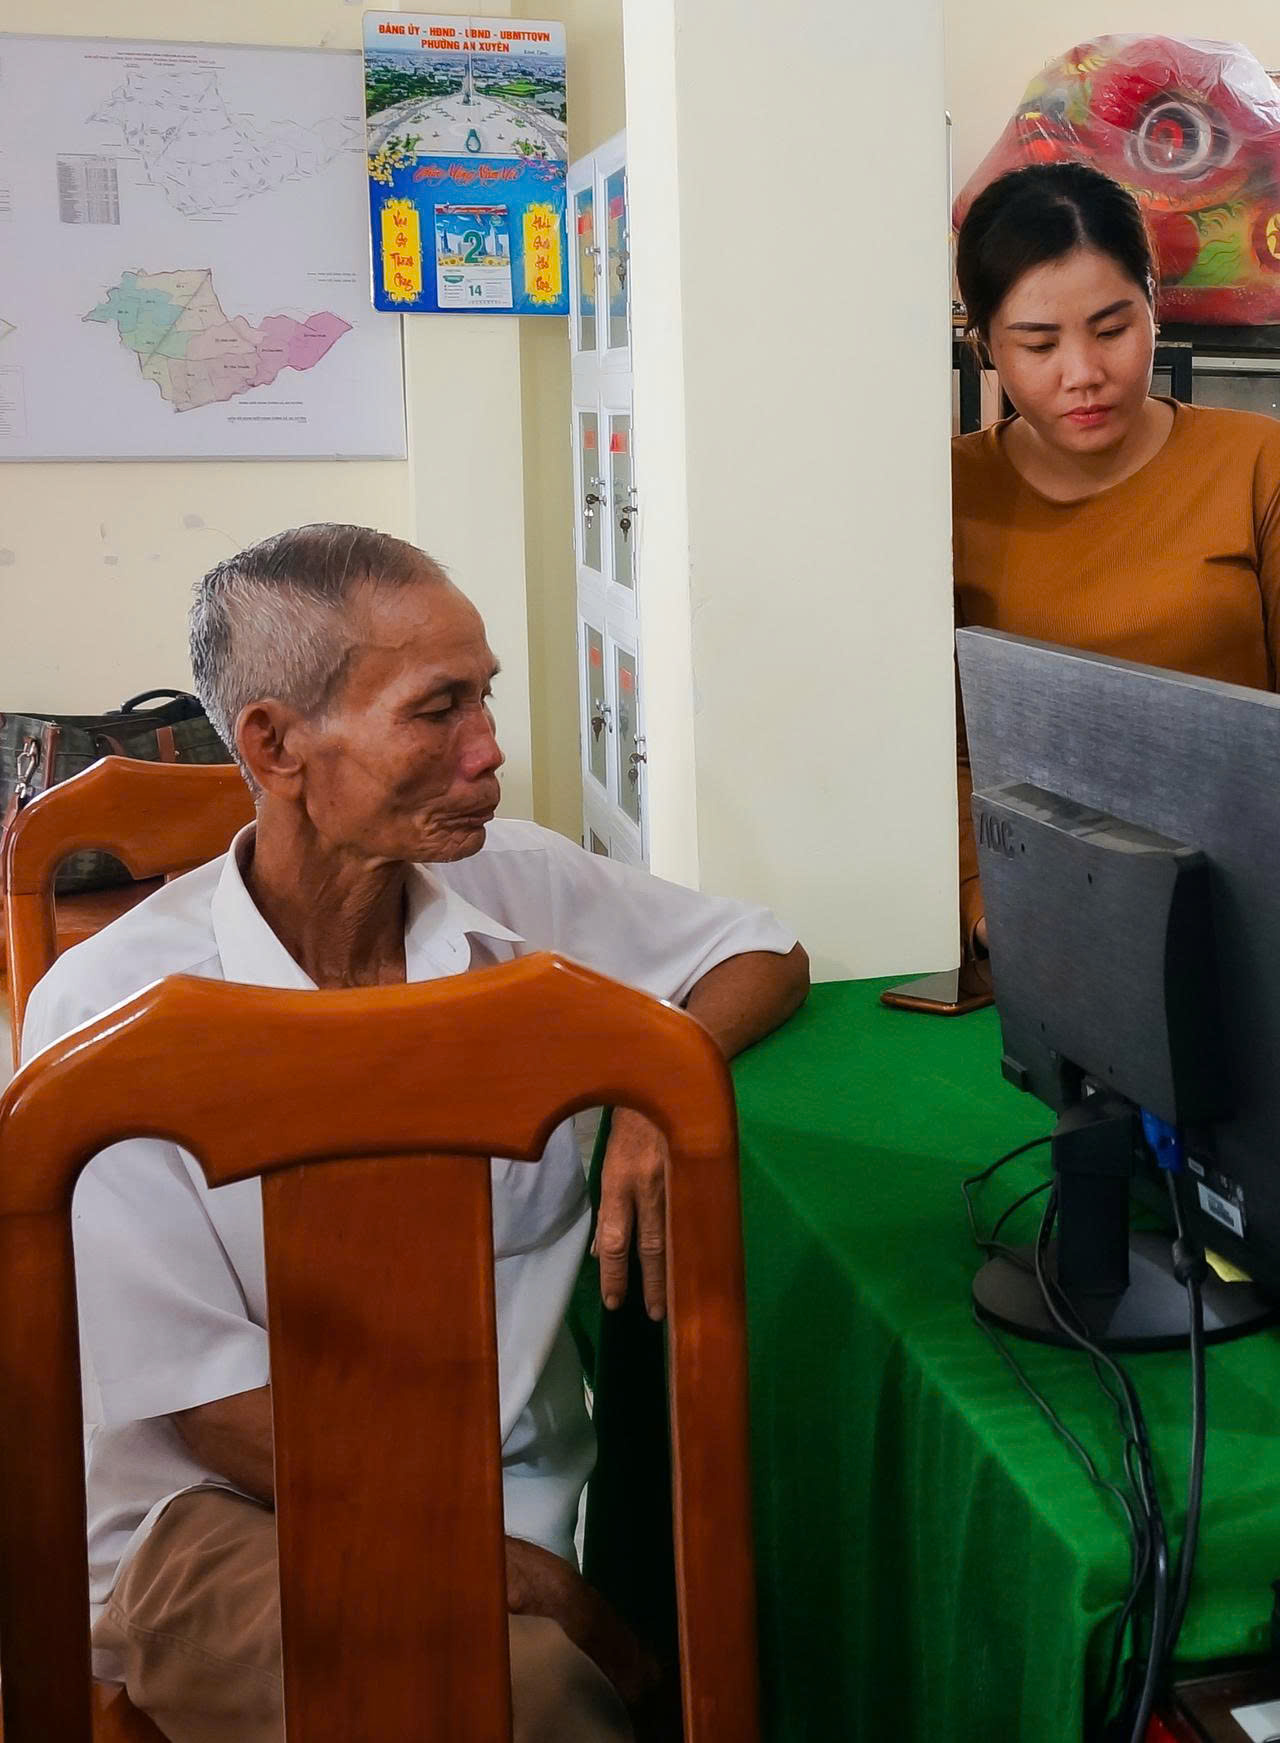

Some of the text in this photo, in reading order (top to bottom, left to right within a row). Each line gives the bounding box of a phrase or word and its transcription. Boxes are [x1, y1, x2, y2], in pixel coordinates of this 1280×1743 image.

[379, 22, 405, 35] ĐẢNG
[429, 27, 456, 37] HĐND
[463, 41, 475, 51] AN
[463, 230, 482, 264] 2
[468, 285, 482, 297] 14
